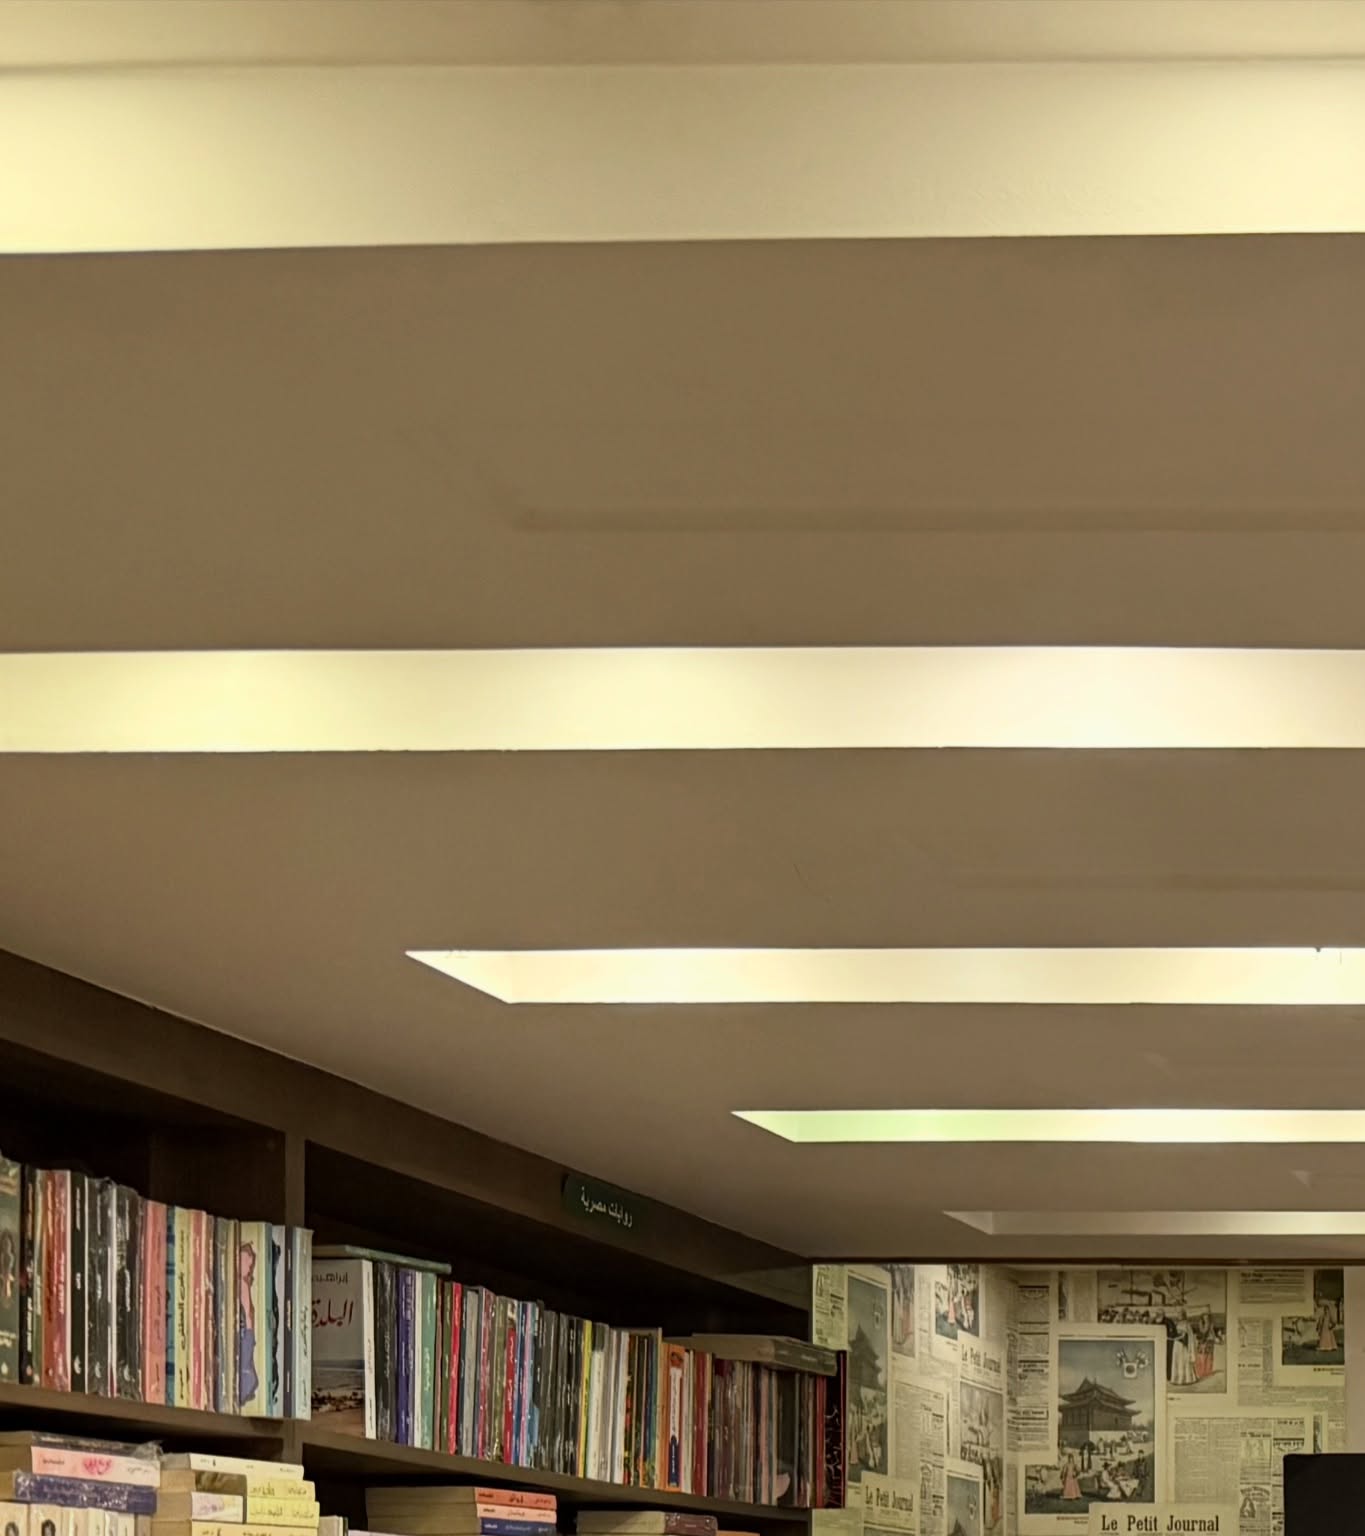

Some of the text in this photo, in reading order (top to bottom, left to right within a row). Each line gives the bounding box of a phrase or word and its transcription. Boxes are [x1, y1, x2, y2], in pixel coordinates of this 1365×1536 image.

[580, 1186, 633, 1228] روايات مصرية
[1101, 1514, 1220, 1532] Le Petit Journal
